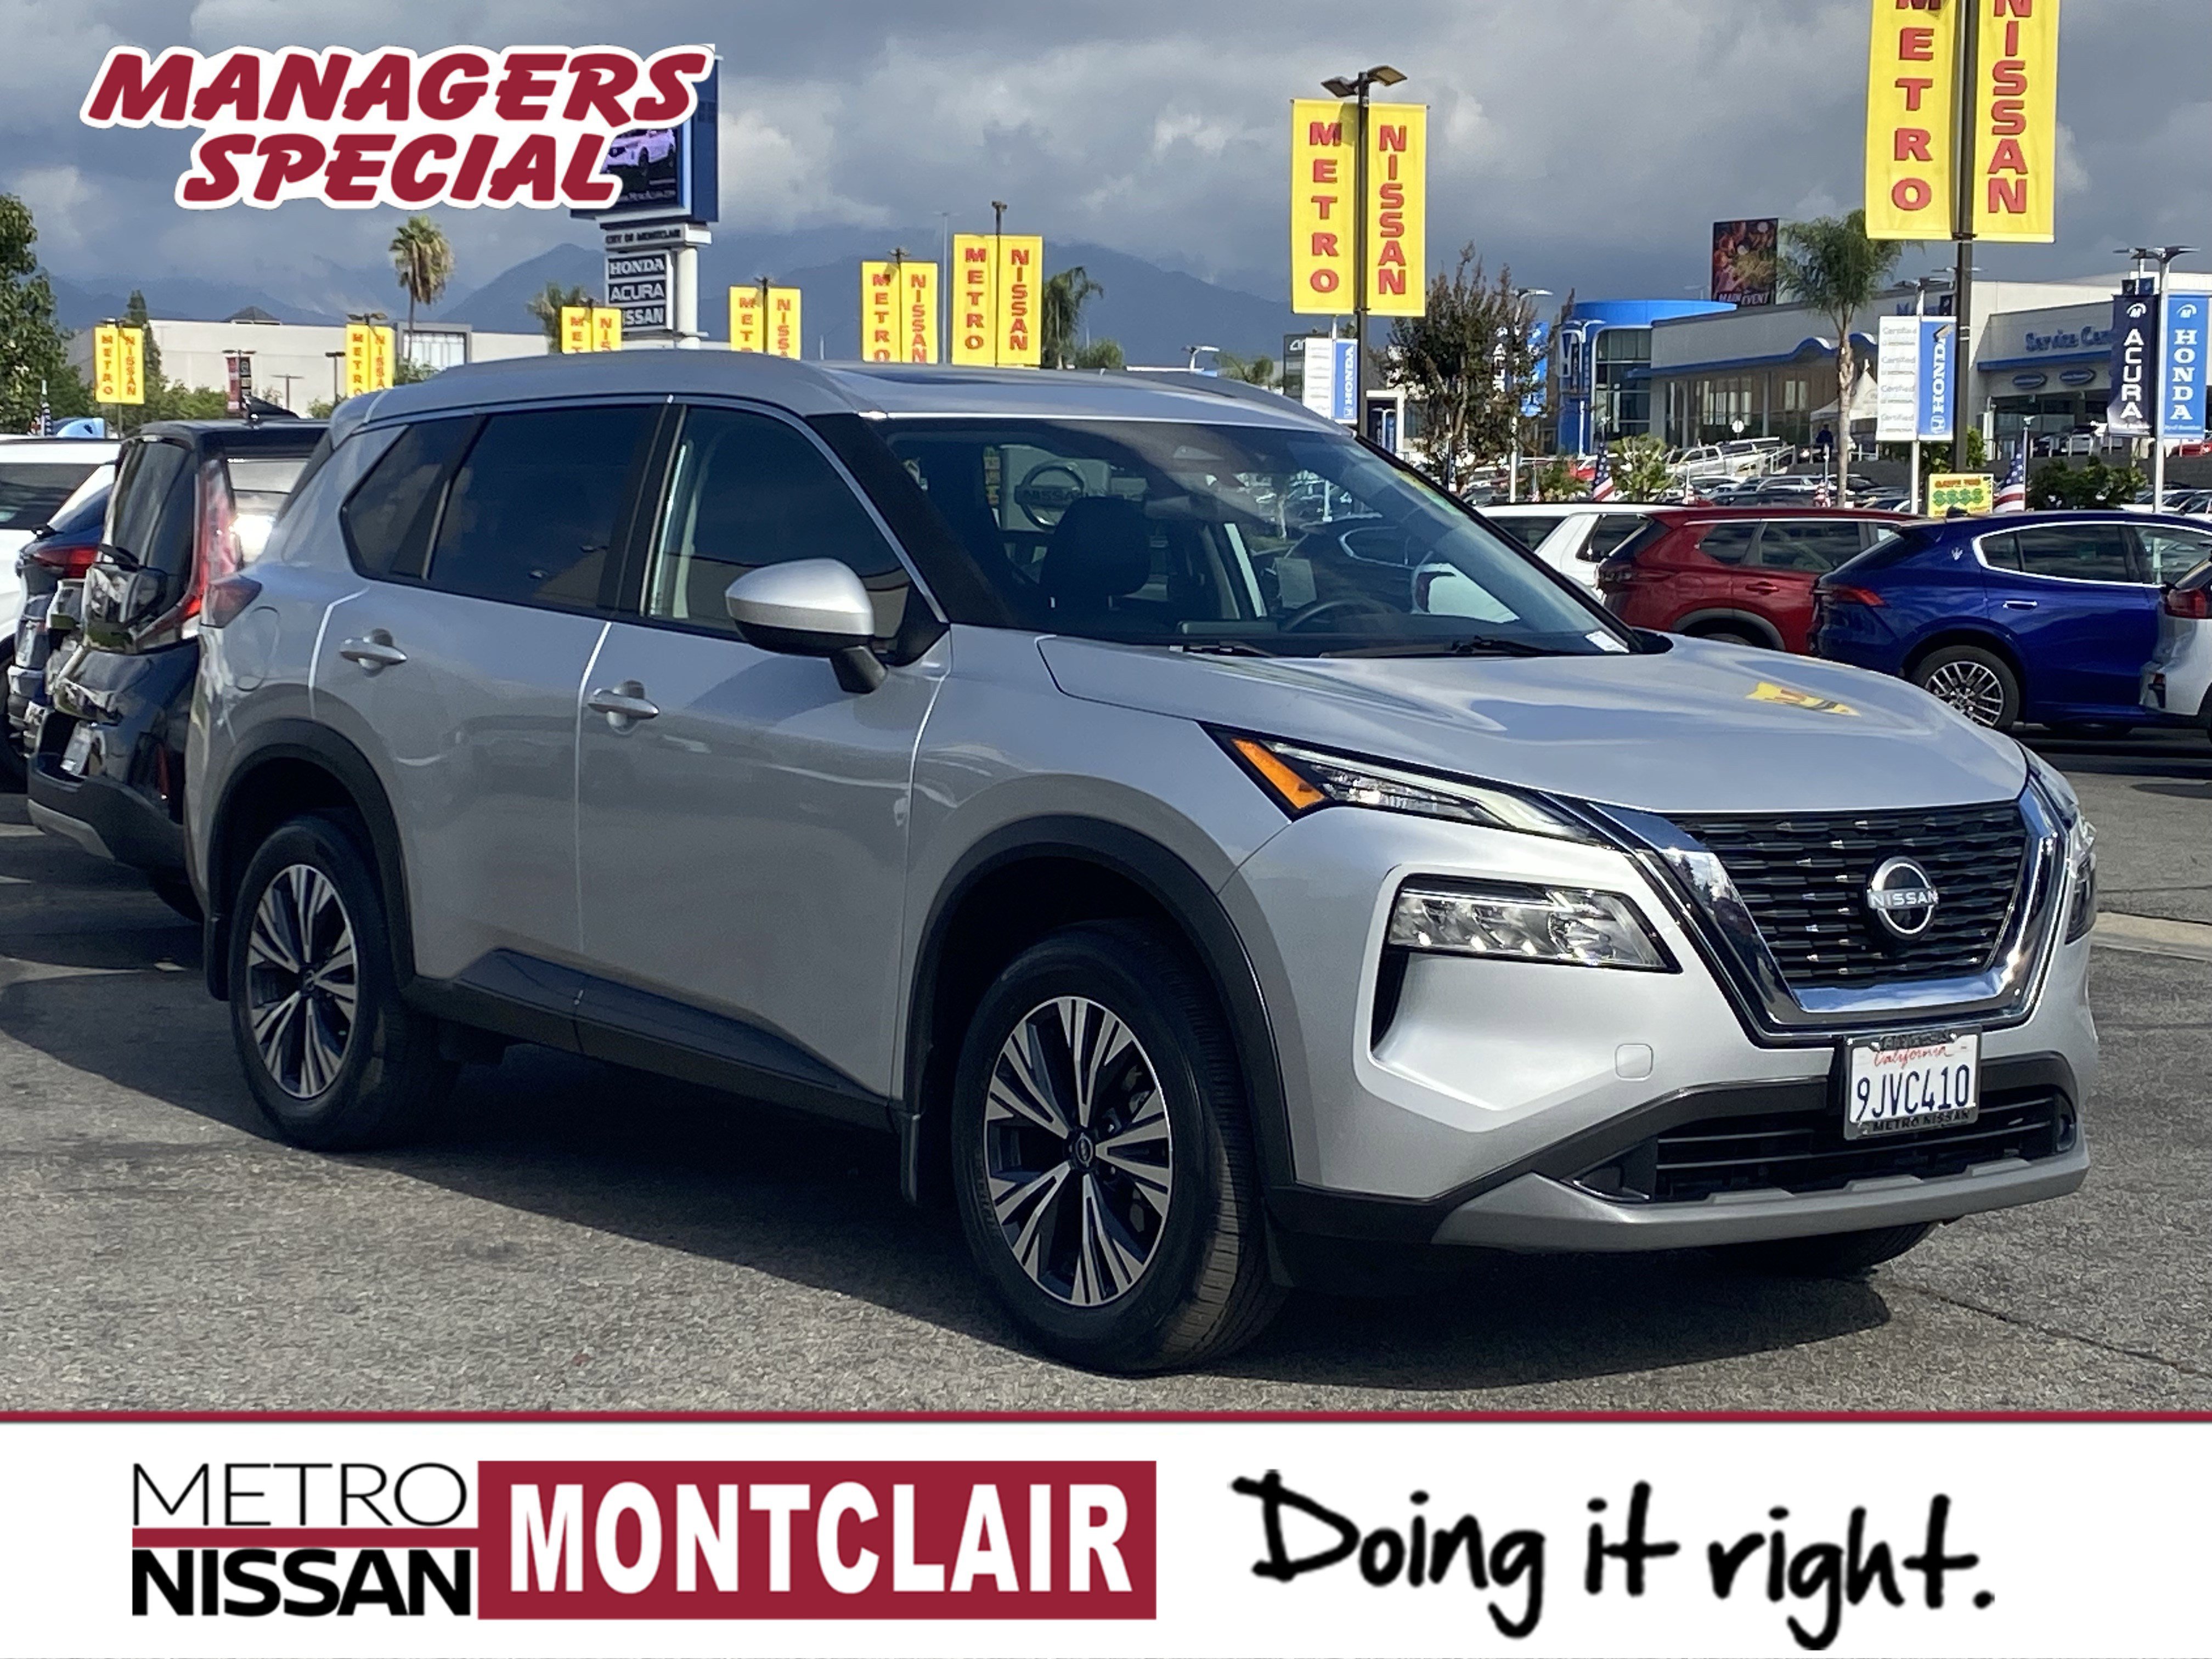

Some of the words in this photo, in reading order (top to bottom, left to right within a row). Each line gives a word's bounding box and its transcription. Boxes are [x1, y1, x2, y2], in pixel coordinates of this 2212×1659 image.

[1309, 121, 1342, 293] METRO
[1378, 125, 1407, 295] NISSAN
[609, 258, 665, 275] HONDA
[610, 283, 665, 302] ACURA
[623, 307, 664, 325] ISSAN
[739, 297, 755, 352] MET
[872, 274, 891, 362] METRO
[911, 274, 927, 363] NISSAN
[964, 247, 986, 349] METRO
[1009, 249, 1029, 351] NISSAN
[376, 335, 385, 389] NISSA
[570, 316, 584, 353] MET
[600, 317, 612, 351] NIS
[101, 335, 113, 396] METRO
[125, 336, 136, 396] NISSAN
[1345, 345, 1355, 405] HONDA
[2120, 329, 2144, 419] ACURA
[2170, 329, 2198, 420] HONDA
[1871, 890, 1938, 907] NISSAN
[1874, 1045, 1954, 1068] California
[1856, 1064, 1970, 1122] 9JVC410
[1874, 1117, 1920, 1131] METRO
[1923, 1109, 1970, 1124] NISSAN
